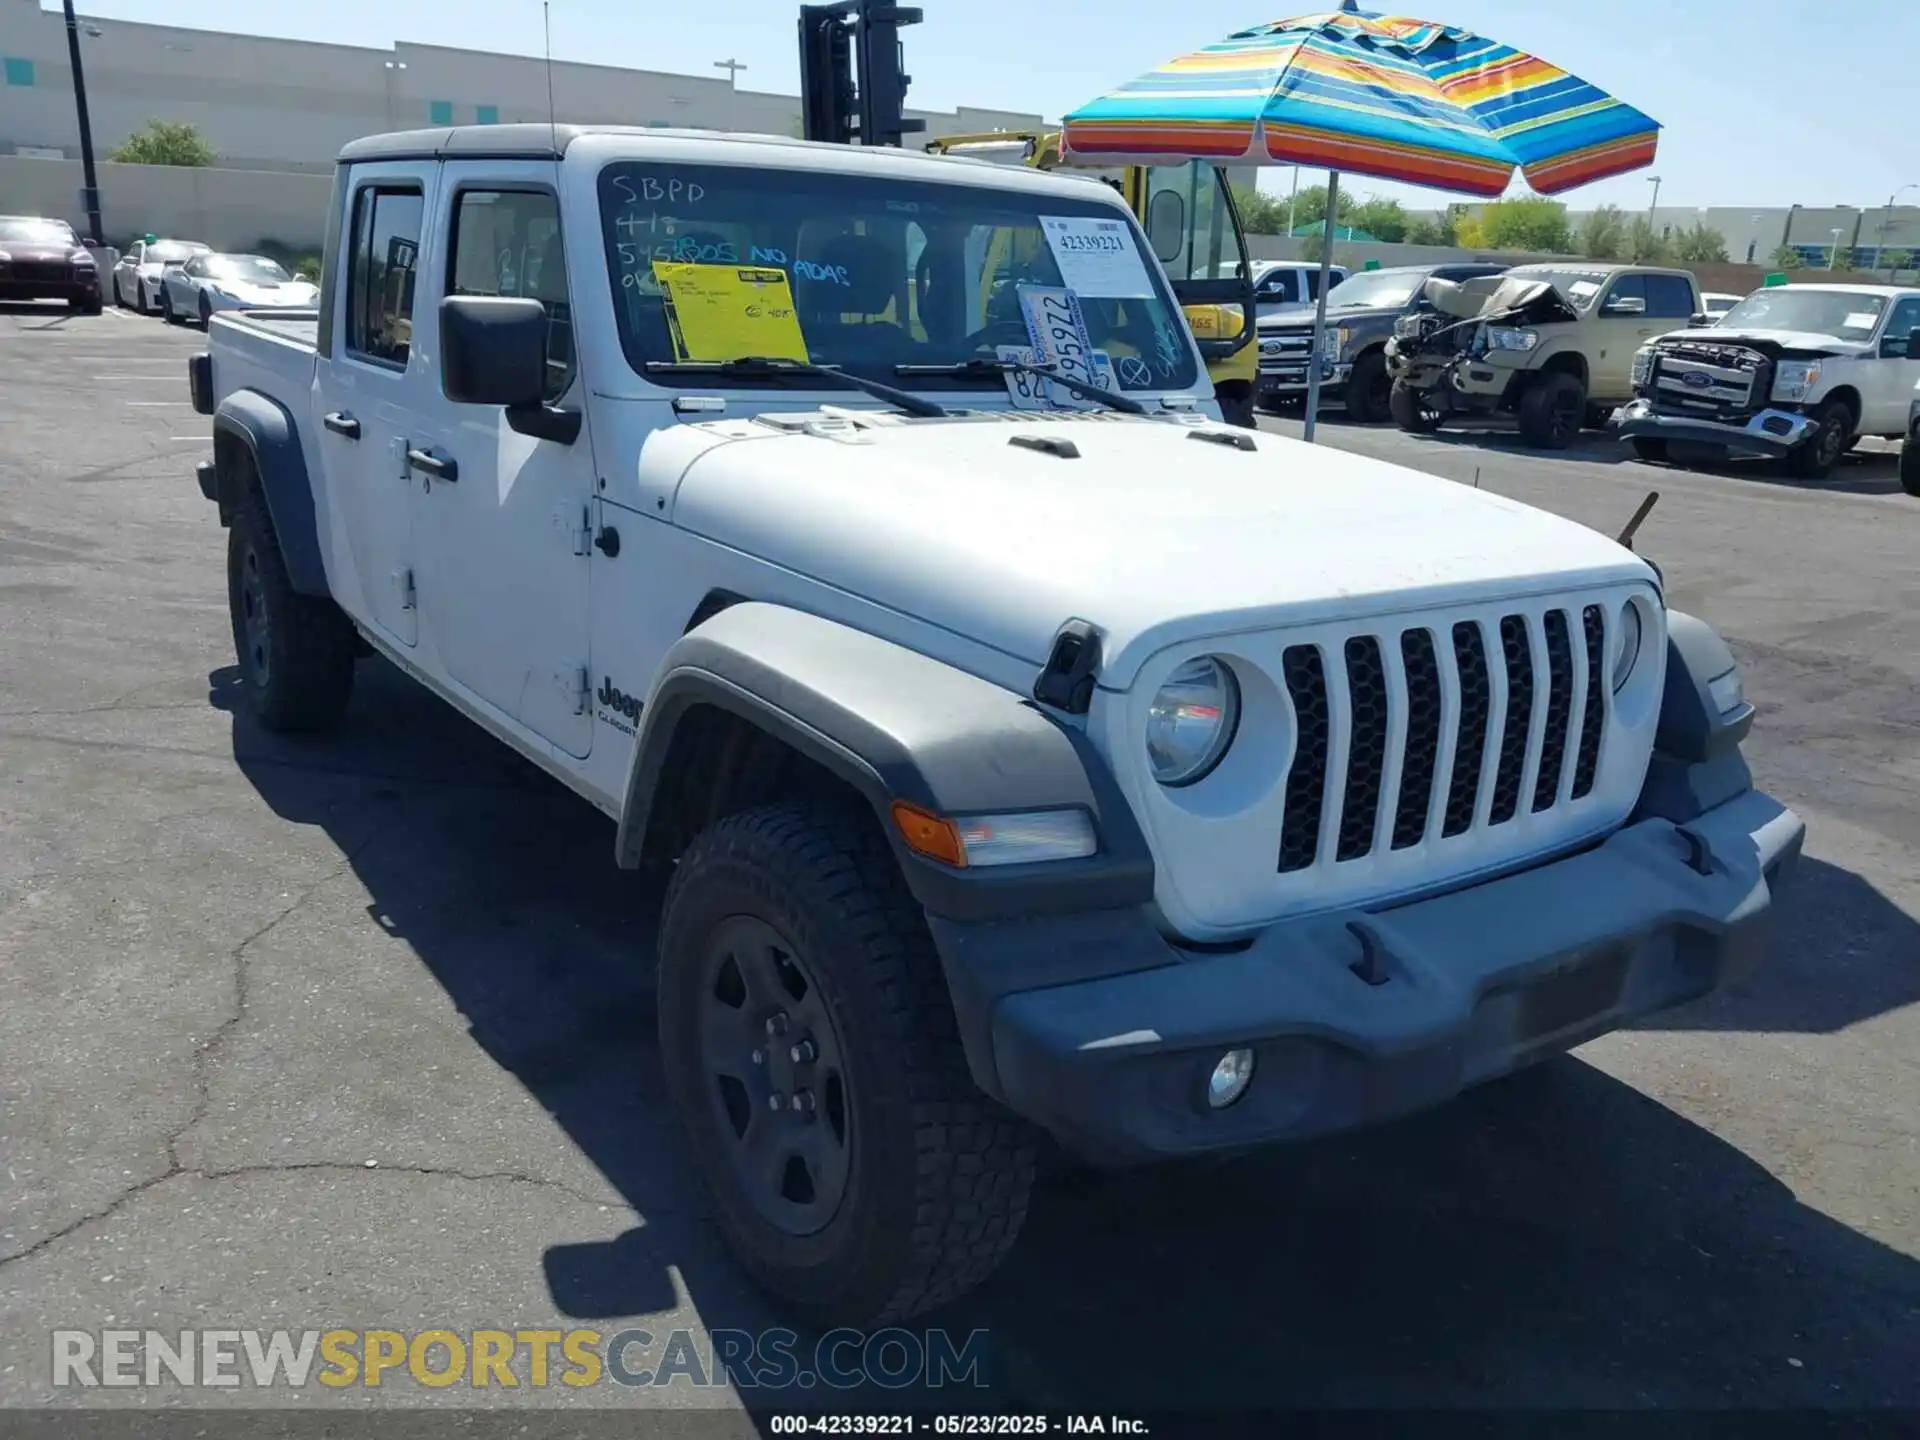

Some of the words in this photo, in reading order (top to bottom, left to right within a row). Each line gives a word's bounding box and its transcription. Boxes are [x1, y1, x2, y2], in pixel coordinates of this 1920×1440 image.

[612, 175, 704, 203] SBPD
[1060, 235, 1124, 250] 42339221
[598, 675, 644, 728] Jeep
